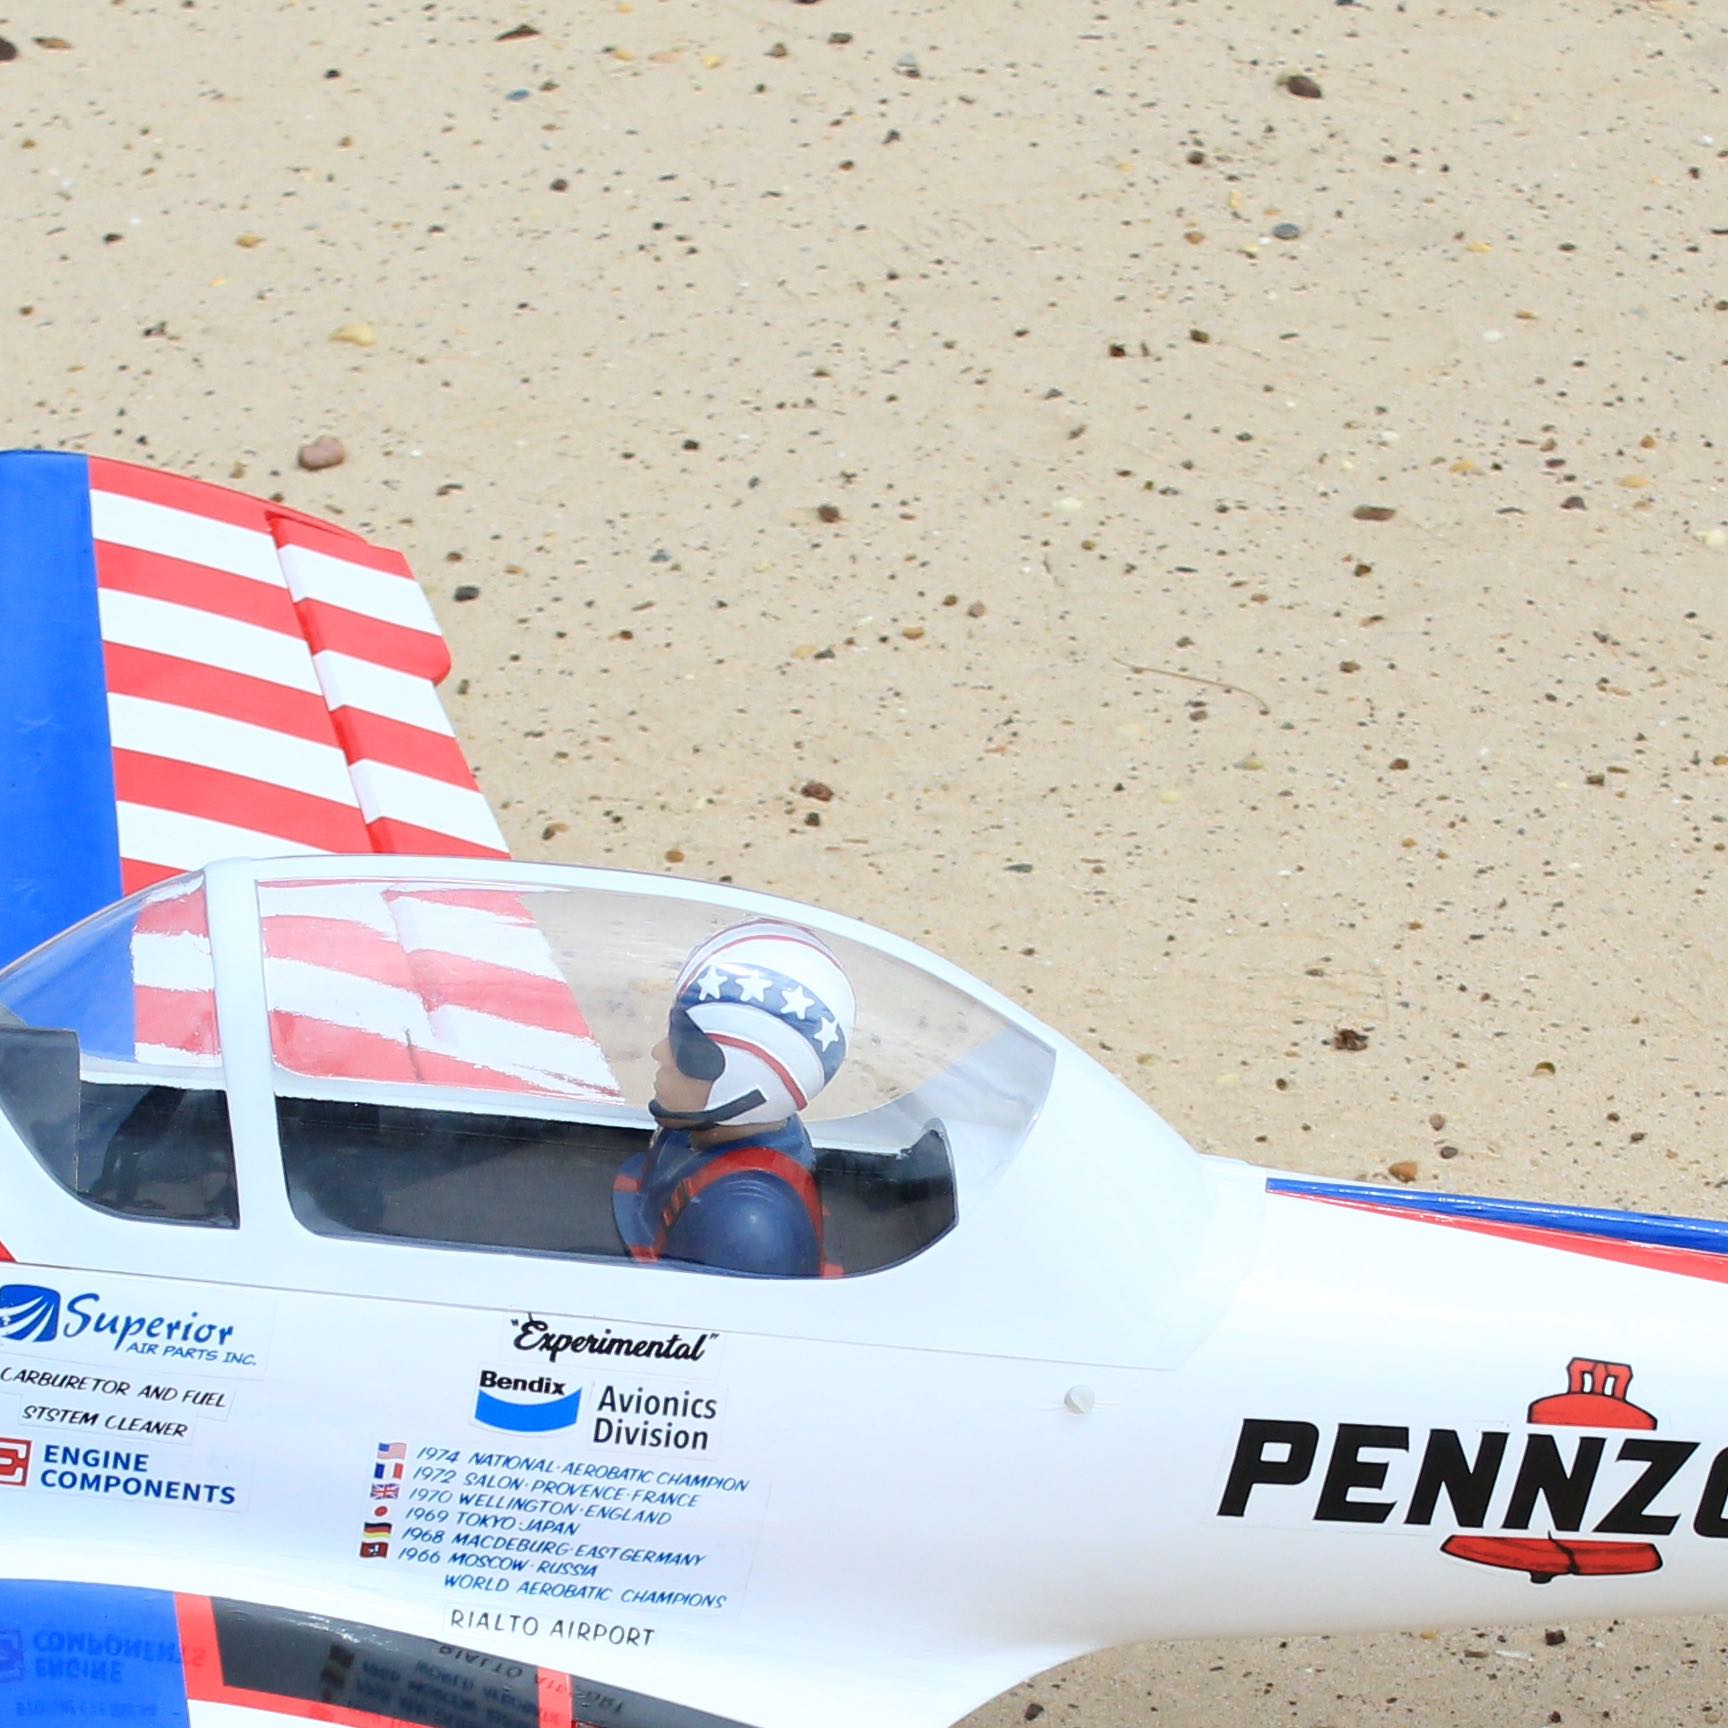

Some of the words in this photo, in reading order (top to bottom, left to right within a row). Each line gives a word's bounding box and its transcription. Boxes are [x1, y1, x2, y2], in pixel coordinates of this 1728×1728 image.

[62, 1292, 234, 1350] Superior
[126, 1341, 160, 1356] AIR
[163, 1345, 219, 1361] PARTS
[222, 1351, 257, 1366] INC.
[0, 1366, 130, 1396] CARBURETOR
[137, 1384, 178, 1402] AND
[181, 1389, 226, 1408] FUEL
[479, 1370, 566, 1396] Bendix
[597, 1385, 718, 1420] Avionics
[22, 1404, 99, 1426] STSTEM
[104, 1414, 188, 1438] CLEANER
[593, 1417, 709, 1451] Division
[43, 1444, 150, 1473] ENGINE
[412, 1466, 457, 1484] 1972
[416, 1446, 461, 1464] 1974
[656, 1472, 750, 1492] CHAMPION
[40, 1468, 236, 1506] COMPONENTS
[408, 1488, 453, 1504] 1970
[405, 1507, 449, 1524] 1969
[401, 1527, 445, 1544] 1968
[397, 1547, 441, 1564] 1966
[444, 1574, 509, 1593] WORLD
[517, 1581, 613, 1602] AEROBATIC
[620, 1589, 727, 1610] CHAMPIONS
[450, 1609, 539, 1637] RIALTO
[549, 1619, 656, 1647] AIRPORT
